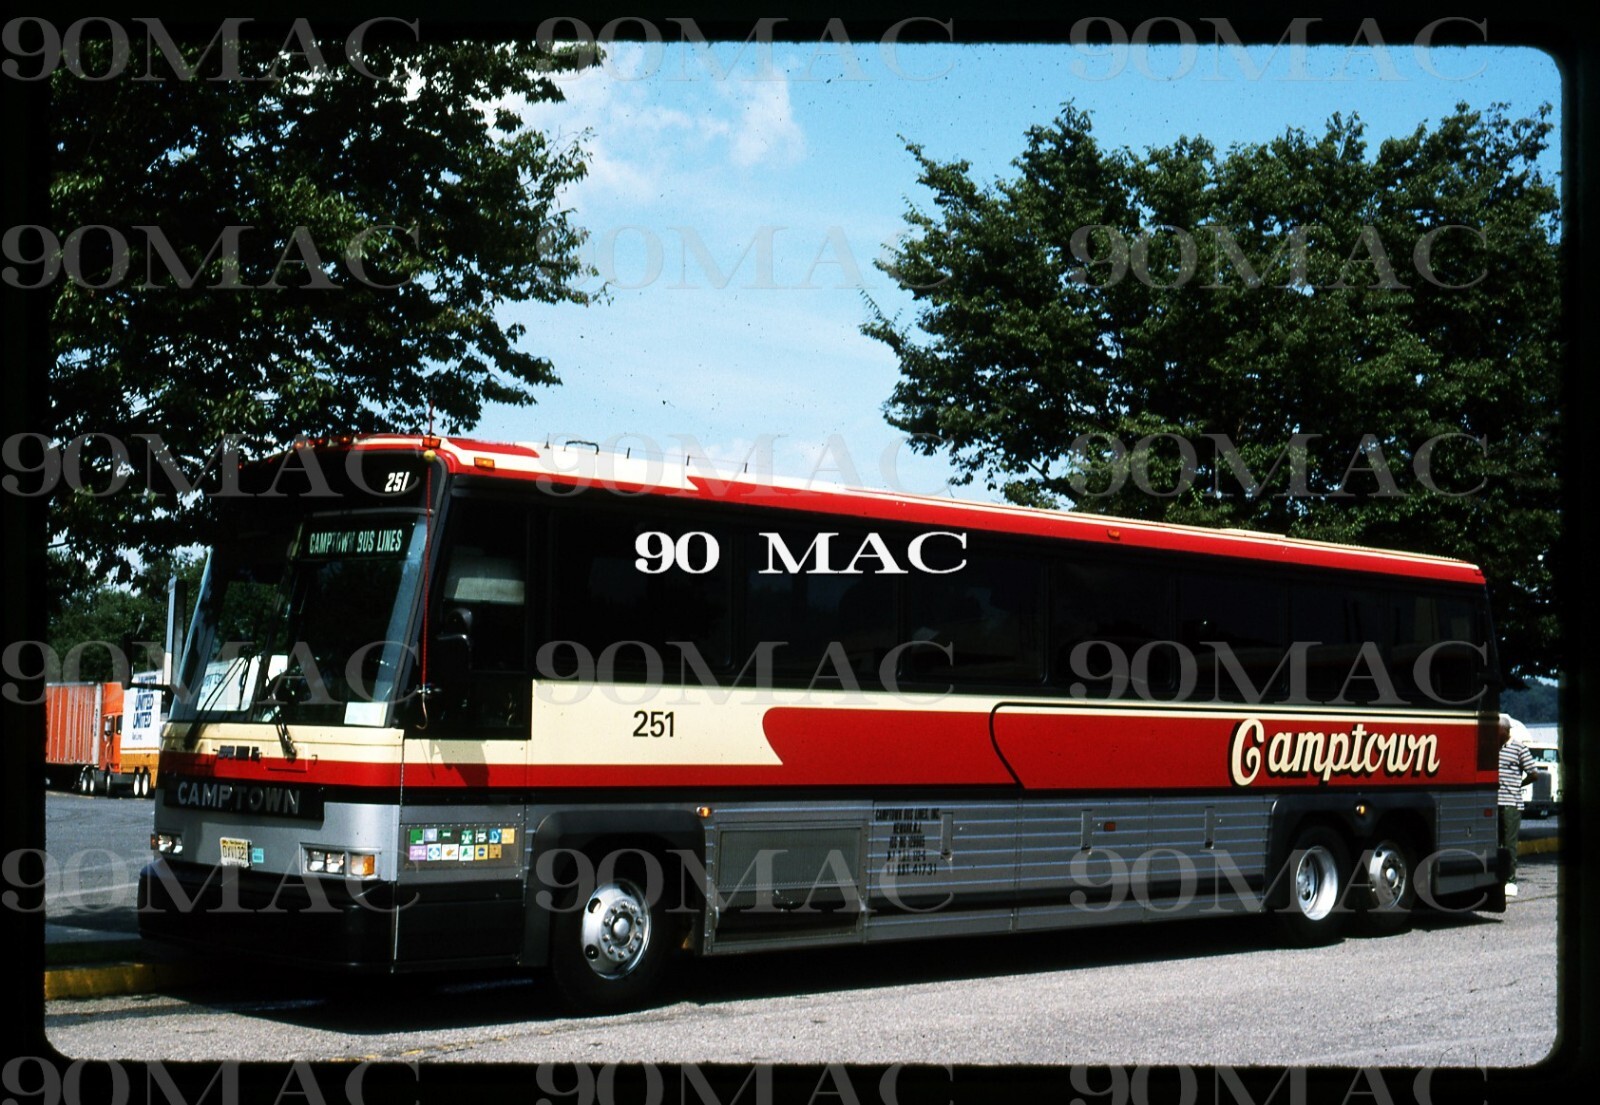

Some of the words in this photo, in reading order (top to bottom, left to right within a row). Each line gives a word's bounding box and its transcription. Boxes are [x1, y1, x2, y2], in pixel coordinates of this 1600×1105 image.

[385, 472, 410, 492] 251
[356, 530, 375, 552] BUS
[376, 529, 403, 552] LINES
[135, 693, 154, 711] UNITED
[133, 711, 151, 729] UNITED
[633, 710, 675, 738] 251
[1230, 717, 1441, 786] Camptown
[178, 781, 300, 815] CAMPTOWN
